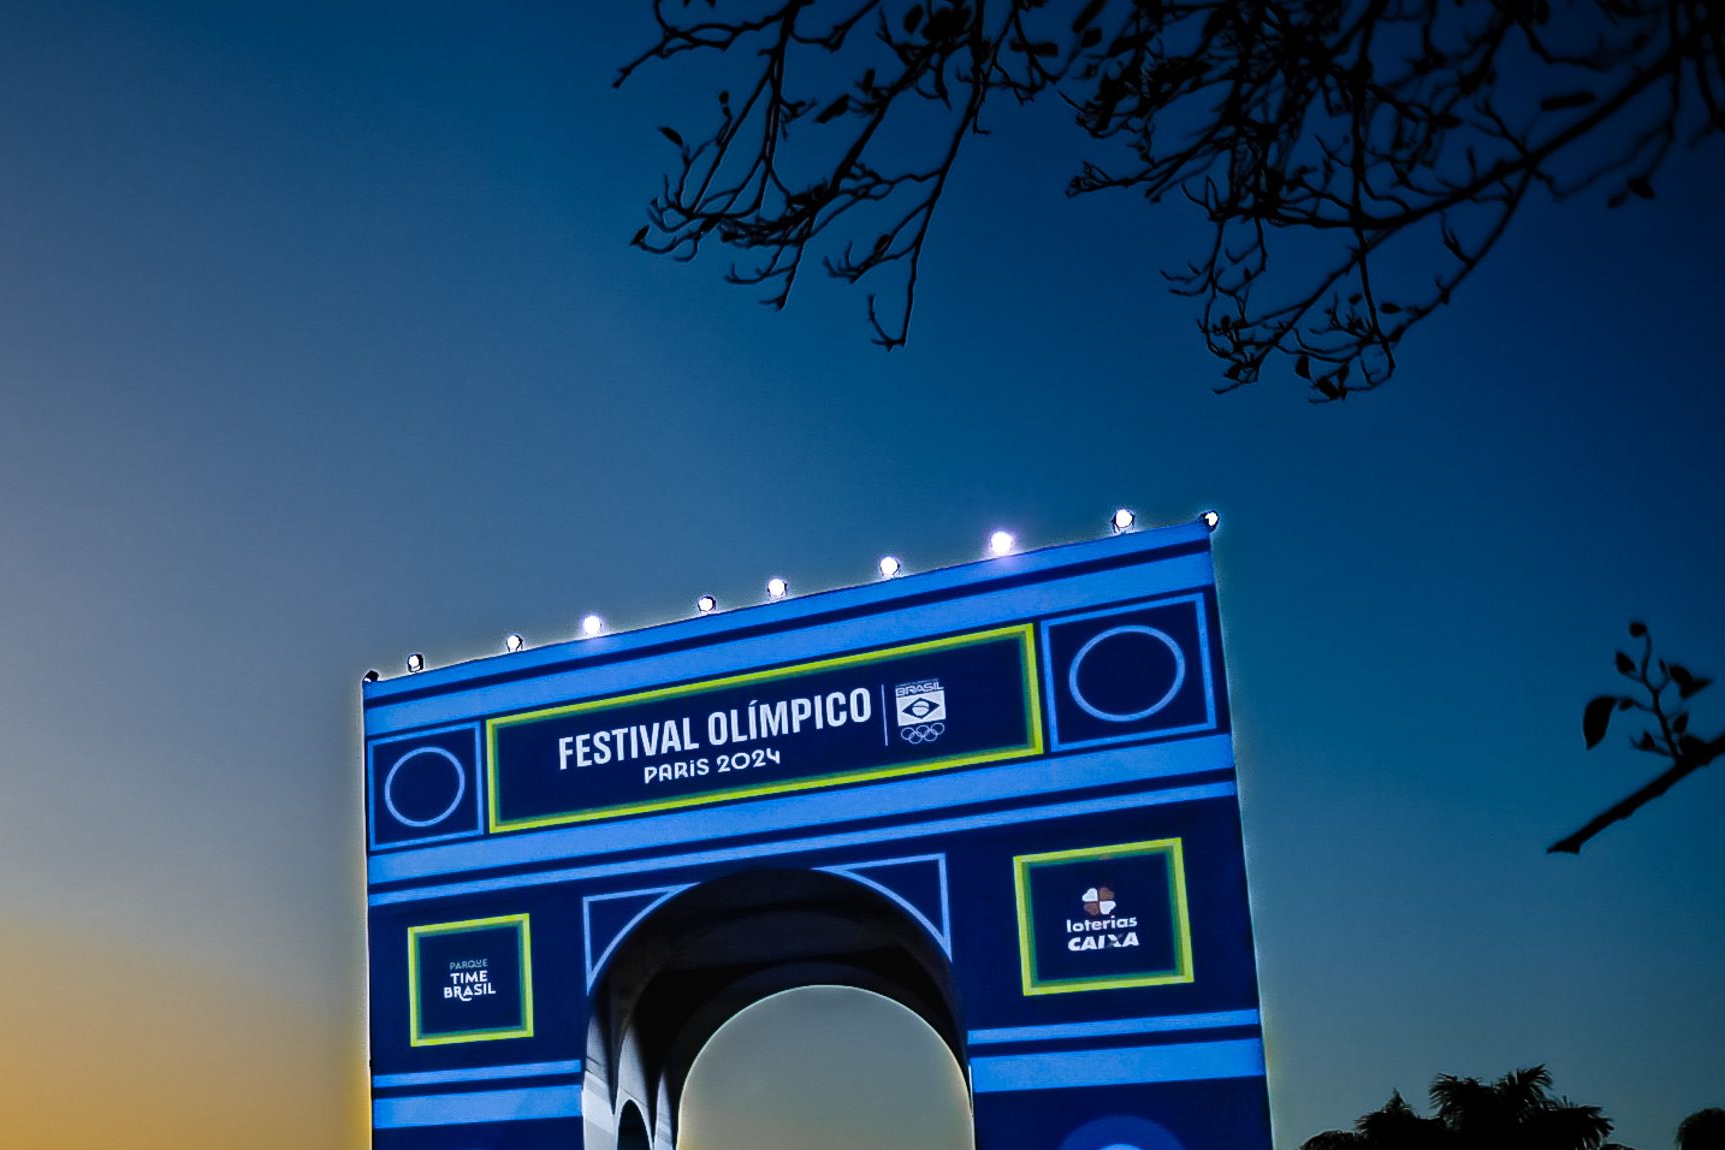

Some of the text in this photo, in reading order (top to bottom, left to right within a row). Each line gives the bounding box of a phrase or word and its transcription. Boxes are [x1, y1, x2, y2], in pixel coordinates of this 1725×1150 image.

[895, 681, 945, 696] BRASIL
[558, 687, 872, 771] FESTIVAL OLÍMPICO
[716, 748, 781, 773] 2024
[1066, 915, 1138, 933] loterias
[1067, 932, 1140, 951] CAIXA
[449, 958, 488, 971] PARQUE
[450, 970, 488, 985] TIME
[443, 982, 497, 1002] BRASIL
